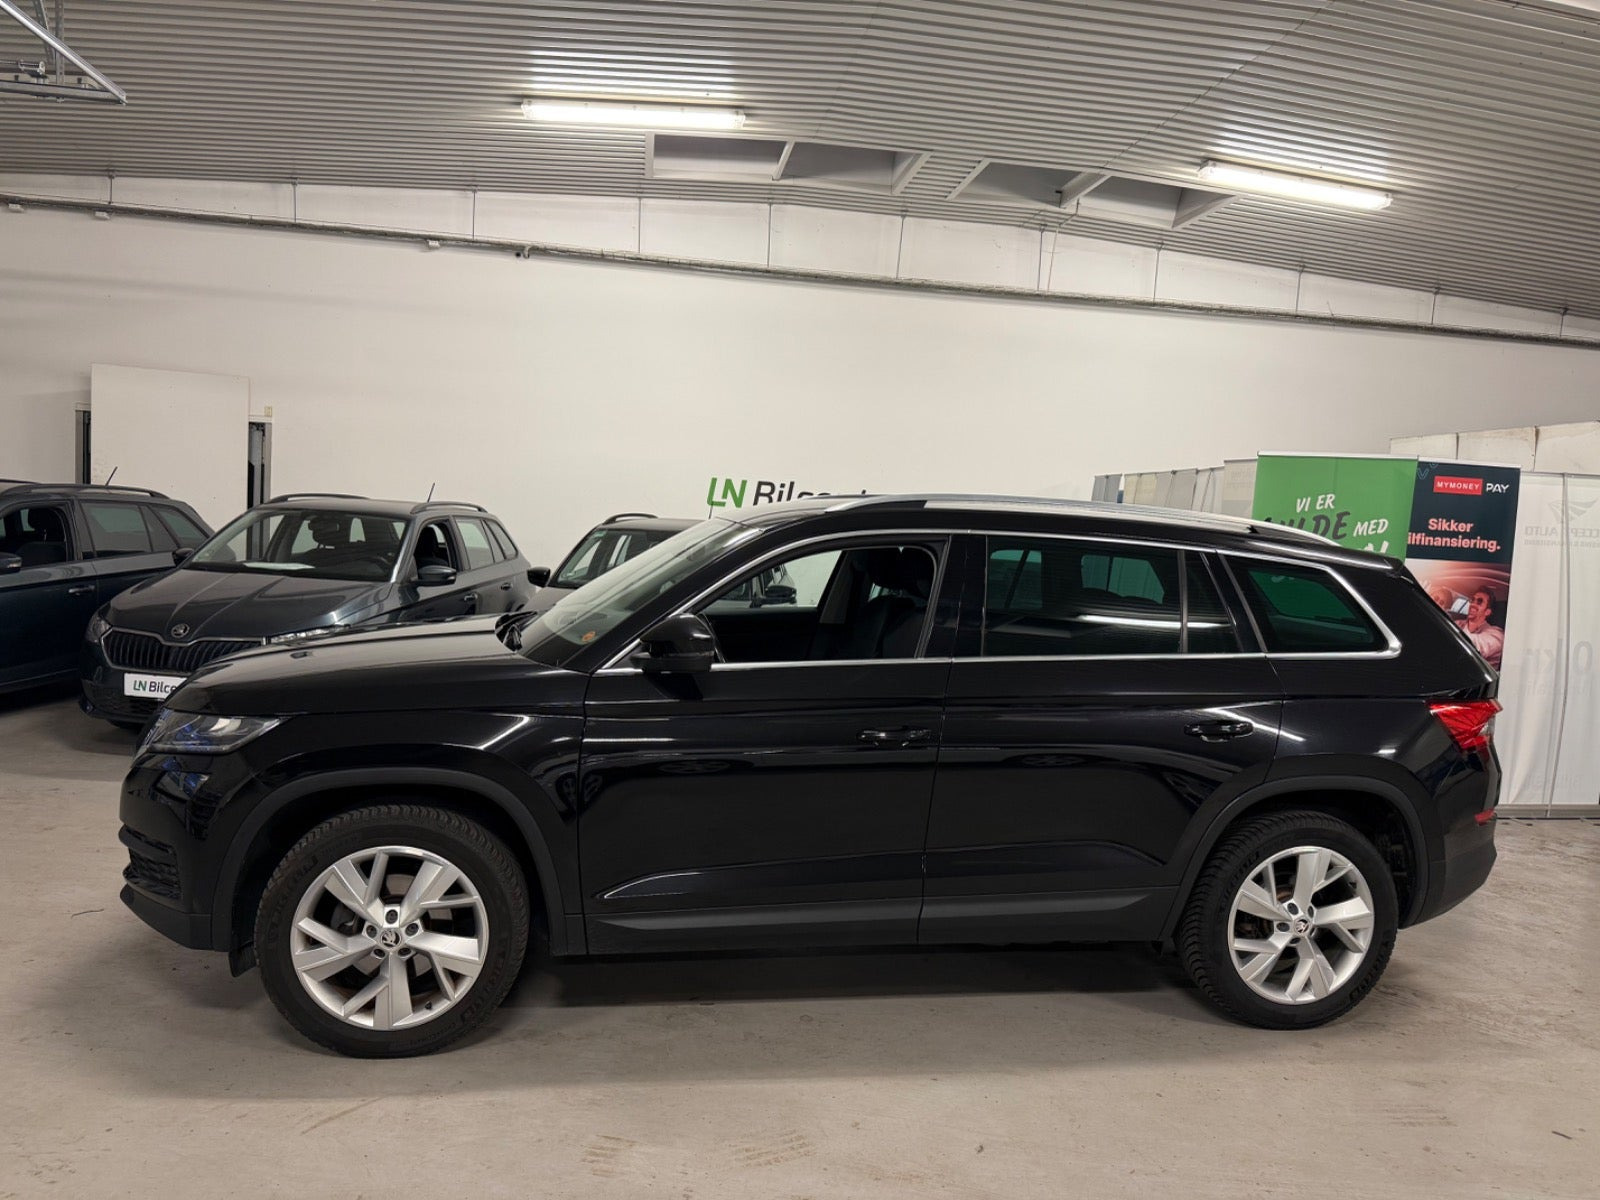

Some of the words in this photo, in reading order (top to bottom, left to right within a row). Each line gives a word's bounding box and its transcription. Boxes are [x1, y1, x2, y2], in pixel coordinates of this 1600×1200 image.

[707, 477, 747, 508] LN
[1436, 481, 1480, 490] MYMONEY
[1486, 483, 1509, 493] PAY
[1296, 497, 1311, 512] VI
[1316, 493, 1336, 510] ER
[1353, 518, 1389, 537] MED
[1428, 518, 1474, 532] Sikker
[1407, 532, 1501, 553] ilfinansiering.
[133, 680, 147, 692] LN
